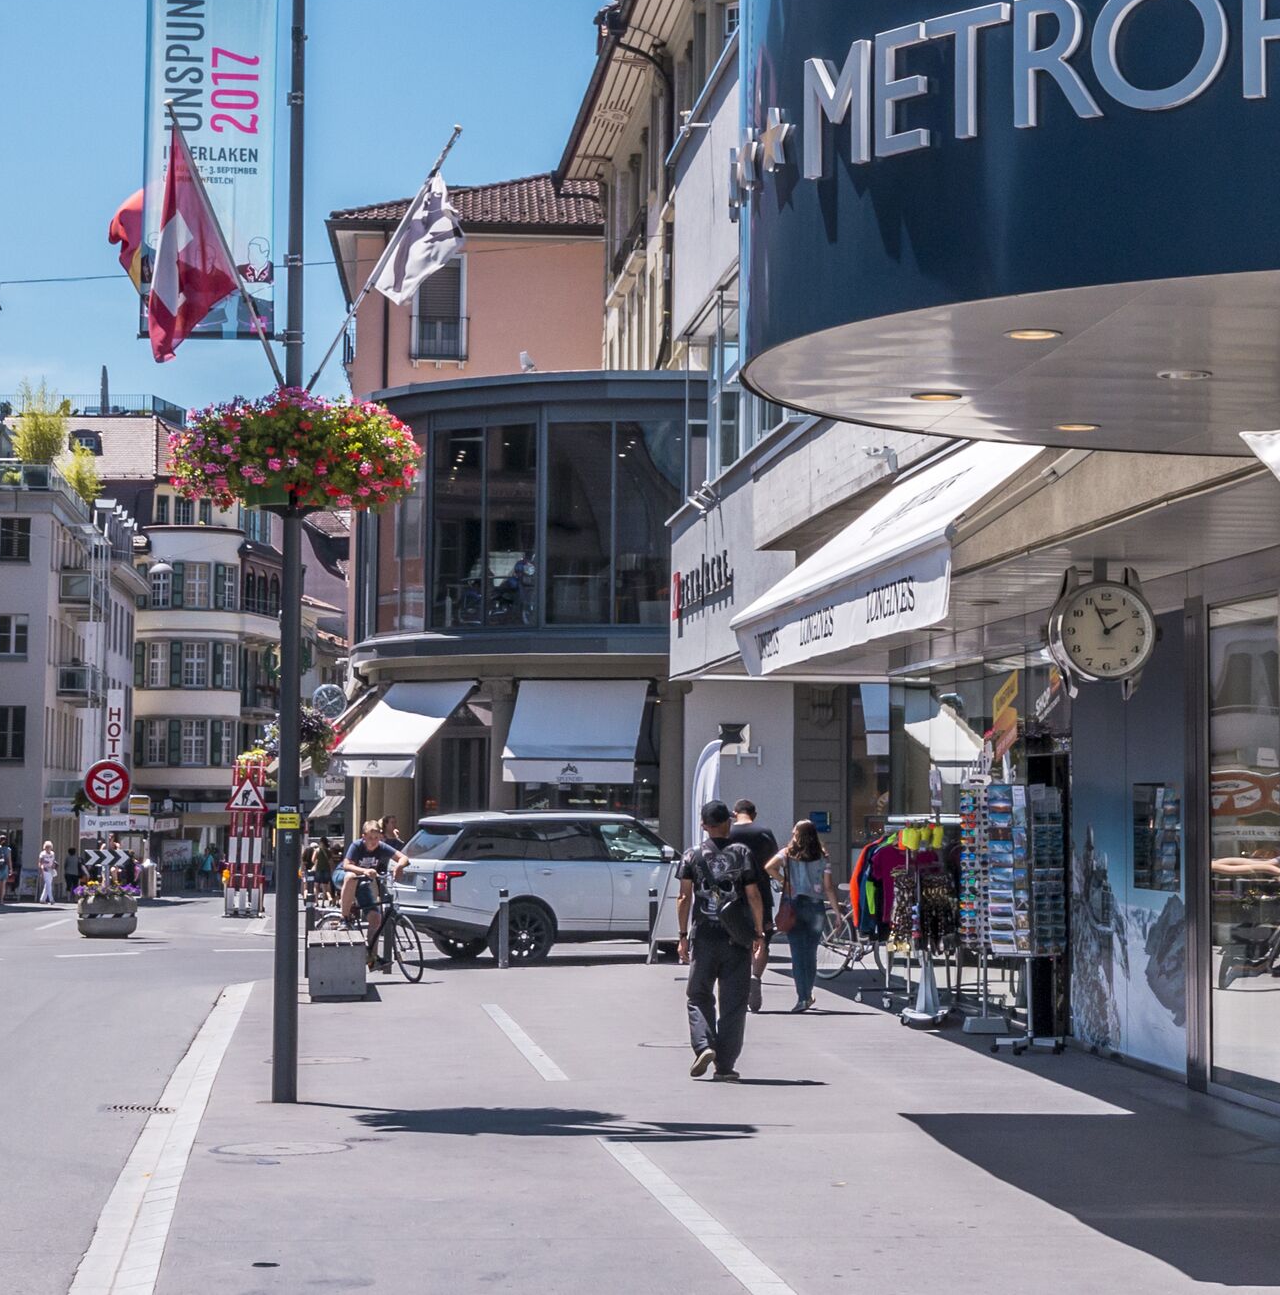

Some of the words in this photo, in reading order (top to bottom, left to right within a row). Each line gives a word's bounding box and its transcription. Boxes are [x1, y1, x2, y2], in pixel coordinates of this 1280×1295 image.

[210, 47, 260, 134] 2017
[163, 145, 258, 163] IERLAKEN
[217, 166, 258, 175] SEPTEMBER
[866, 575, 916, 624] LONGINES
[799, 606, 835, 646] LONGINES
[99, 819, 127, 828] gestattet
